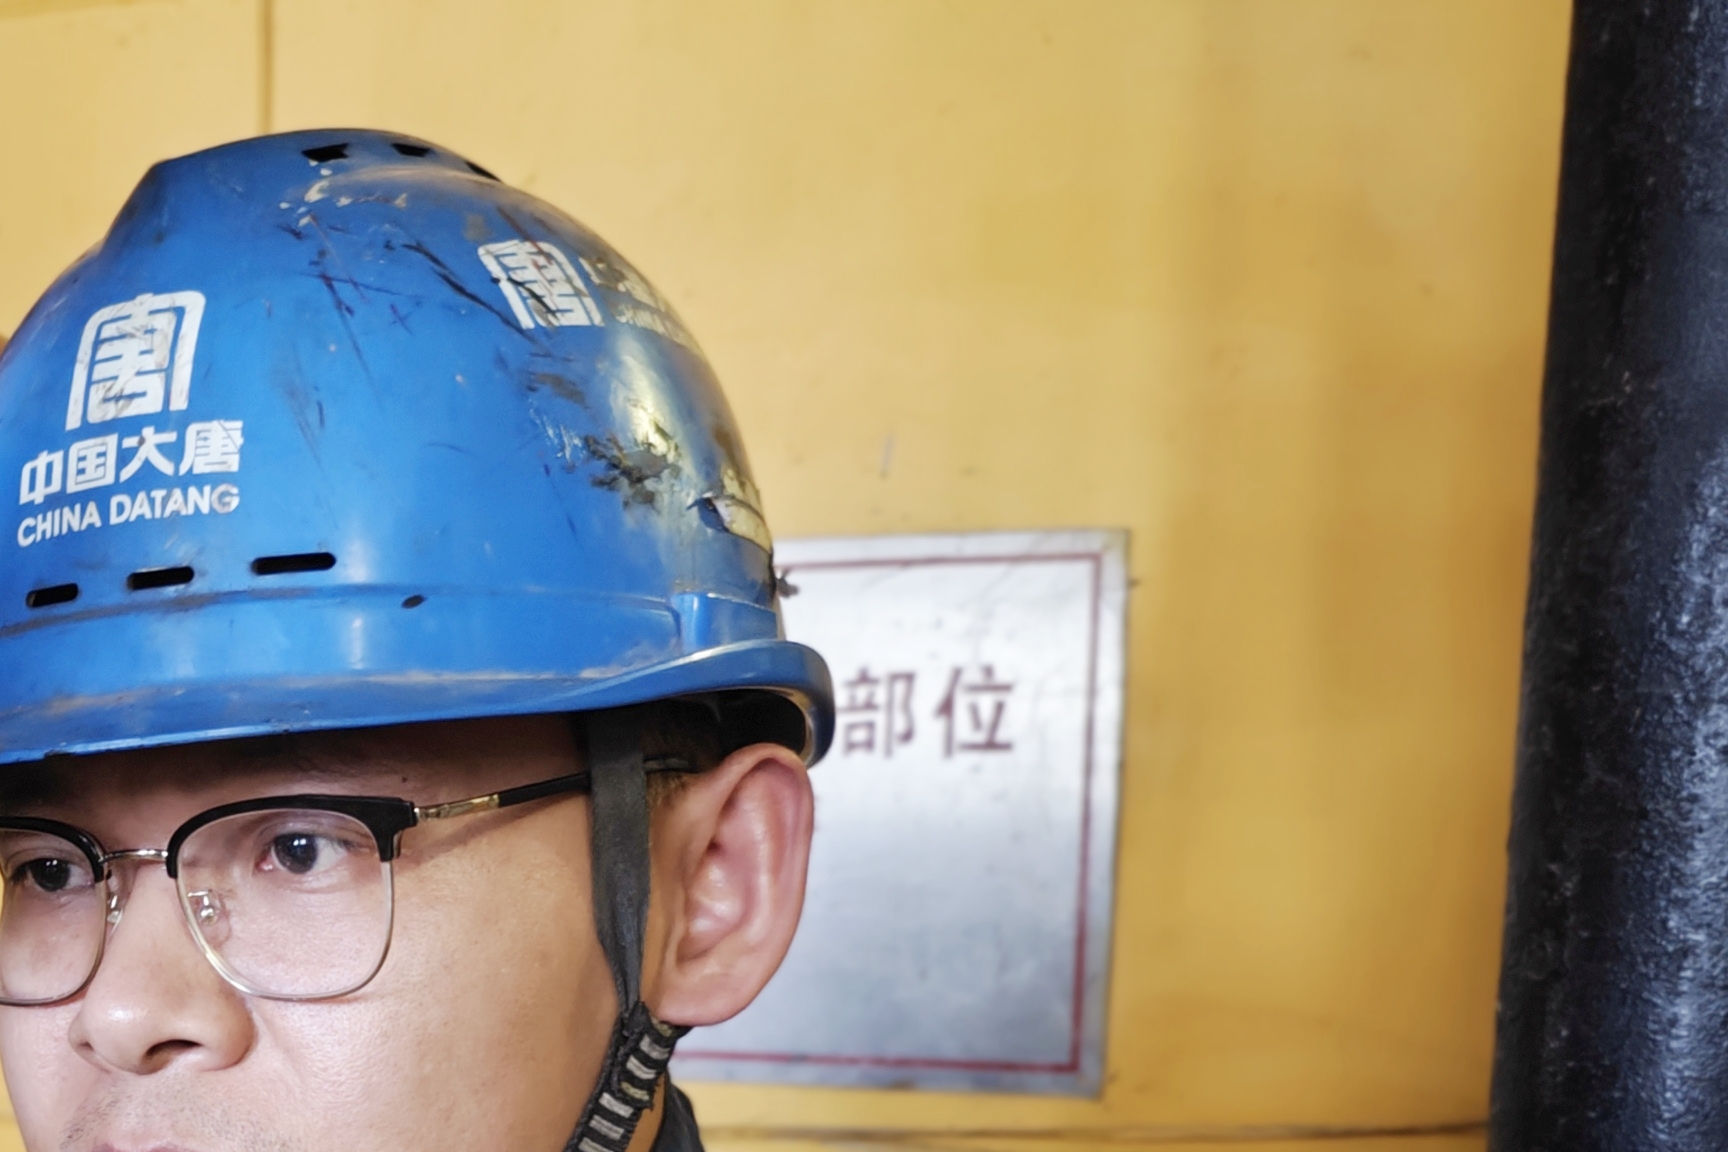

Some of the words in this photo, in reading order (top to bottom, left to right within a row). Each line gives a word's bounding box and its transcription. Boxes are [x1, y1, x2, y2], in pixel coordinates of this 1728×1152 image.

[19, 420, 244, 505] 中国大唐
[17, 501, 101, 547] CHINA
[109, 483, 240, 526] DATANG
[835, 665, 1014, 759] 部位
